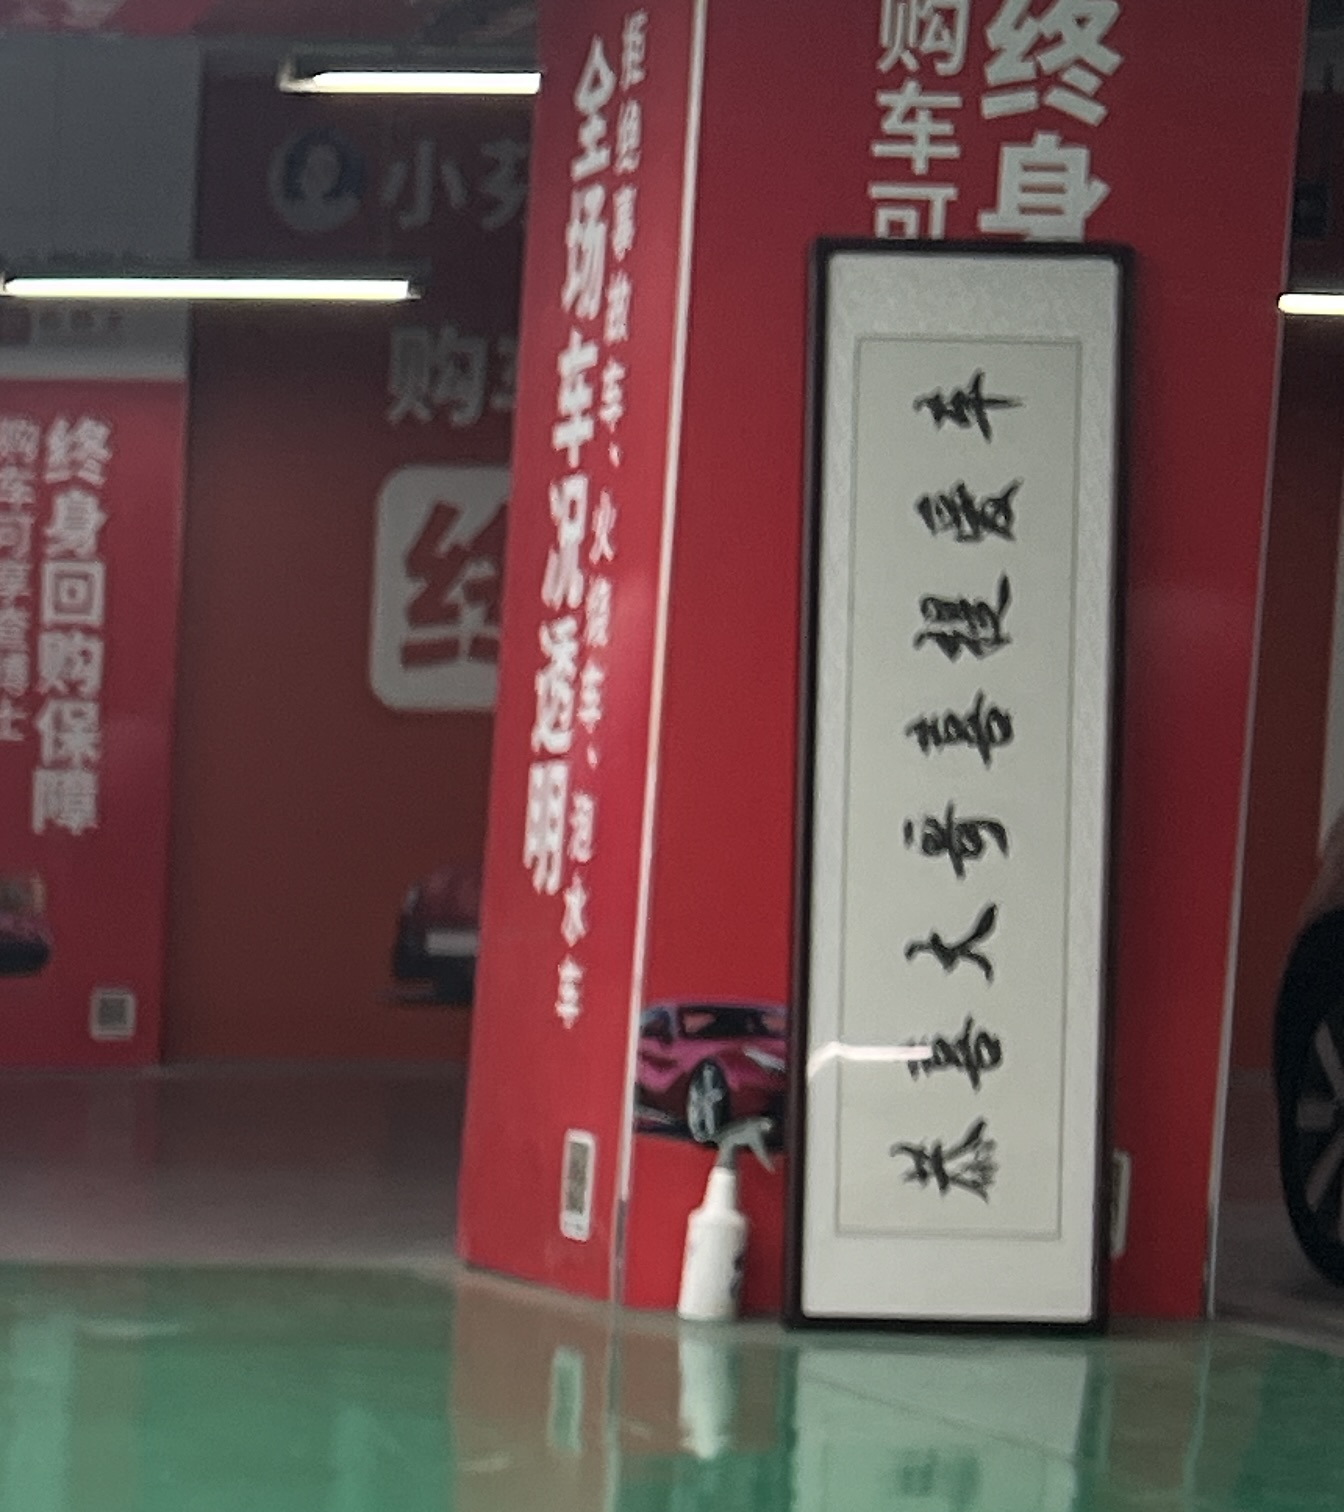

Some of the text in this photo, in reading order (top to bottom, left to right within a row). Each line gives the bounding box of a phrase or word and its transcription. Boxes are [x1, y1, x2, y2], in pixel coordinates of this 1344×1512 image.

[868, 0, 971, 240] 购车可
[976, 0, 1124, 242] 终身
[31, 415, 112, 835] 终身回购保障
